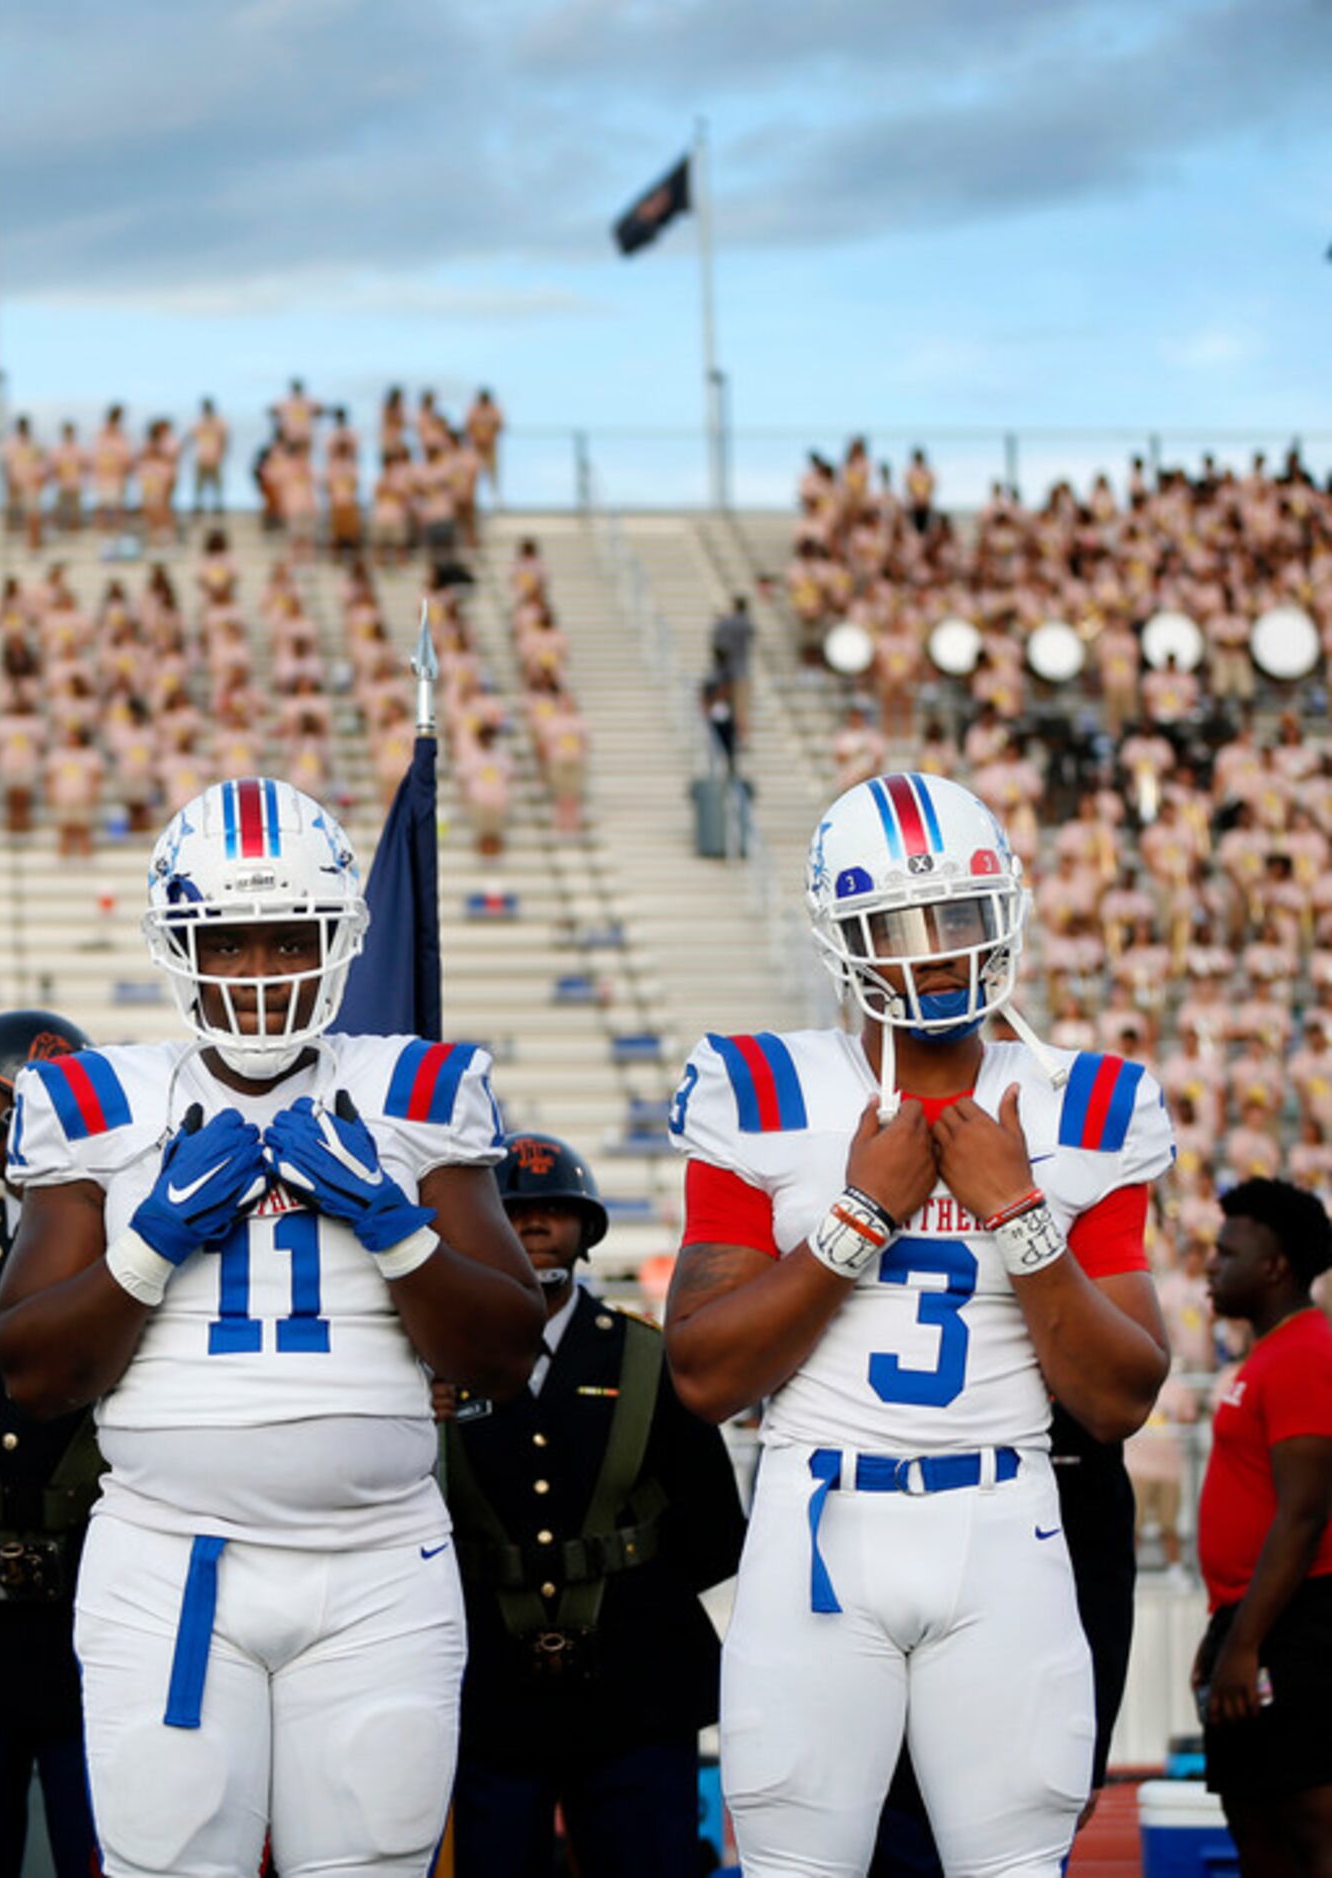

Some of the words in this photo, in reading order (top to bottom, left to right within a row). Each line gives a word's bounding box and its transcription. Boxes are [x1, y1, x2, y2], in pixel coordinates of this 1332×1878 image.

[844, 875, 858, 893] 3
[668, 1063, 698, 1135] 3
[202, 1212, 331, 1356] 11
[867, 1236, 979, 1408] 3
